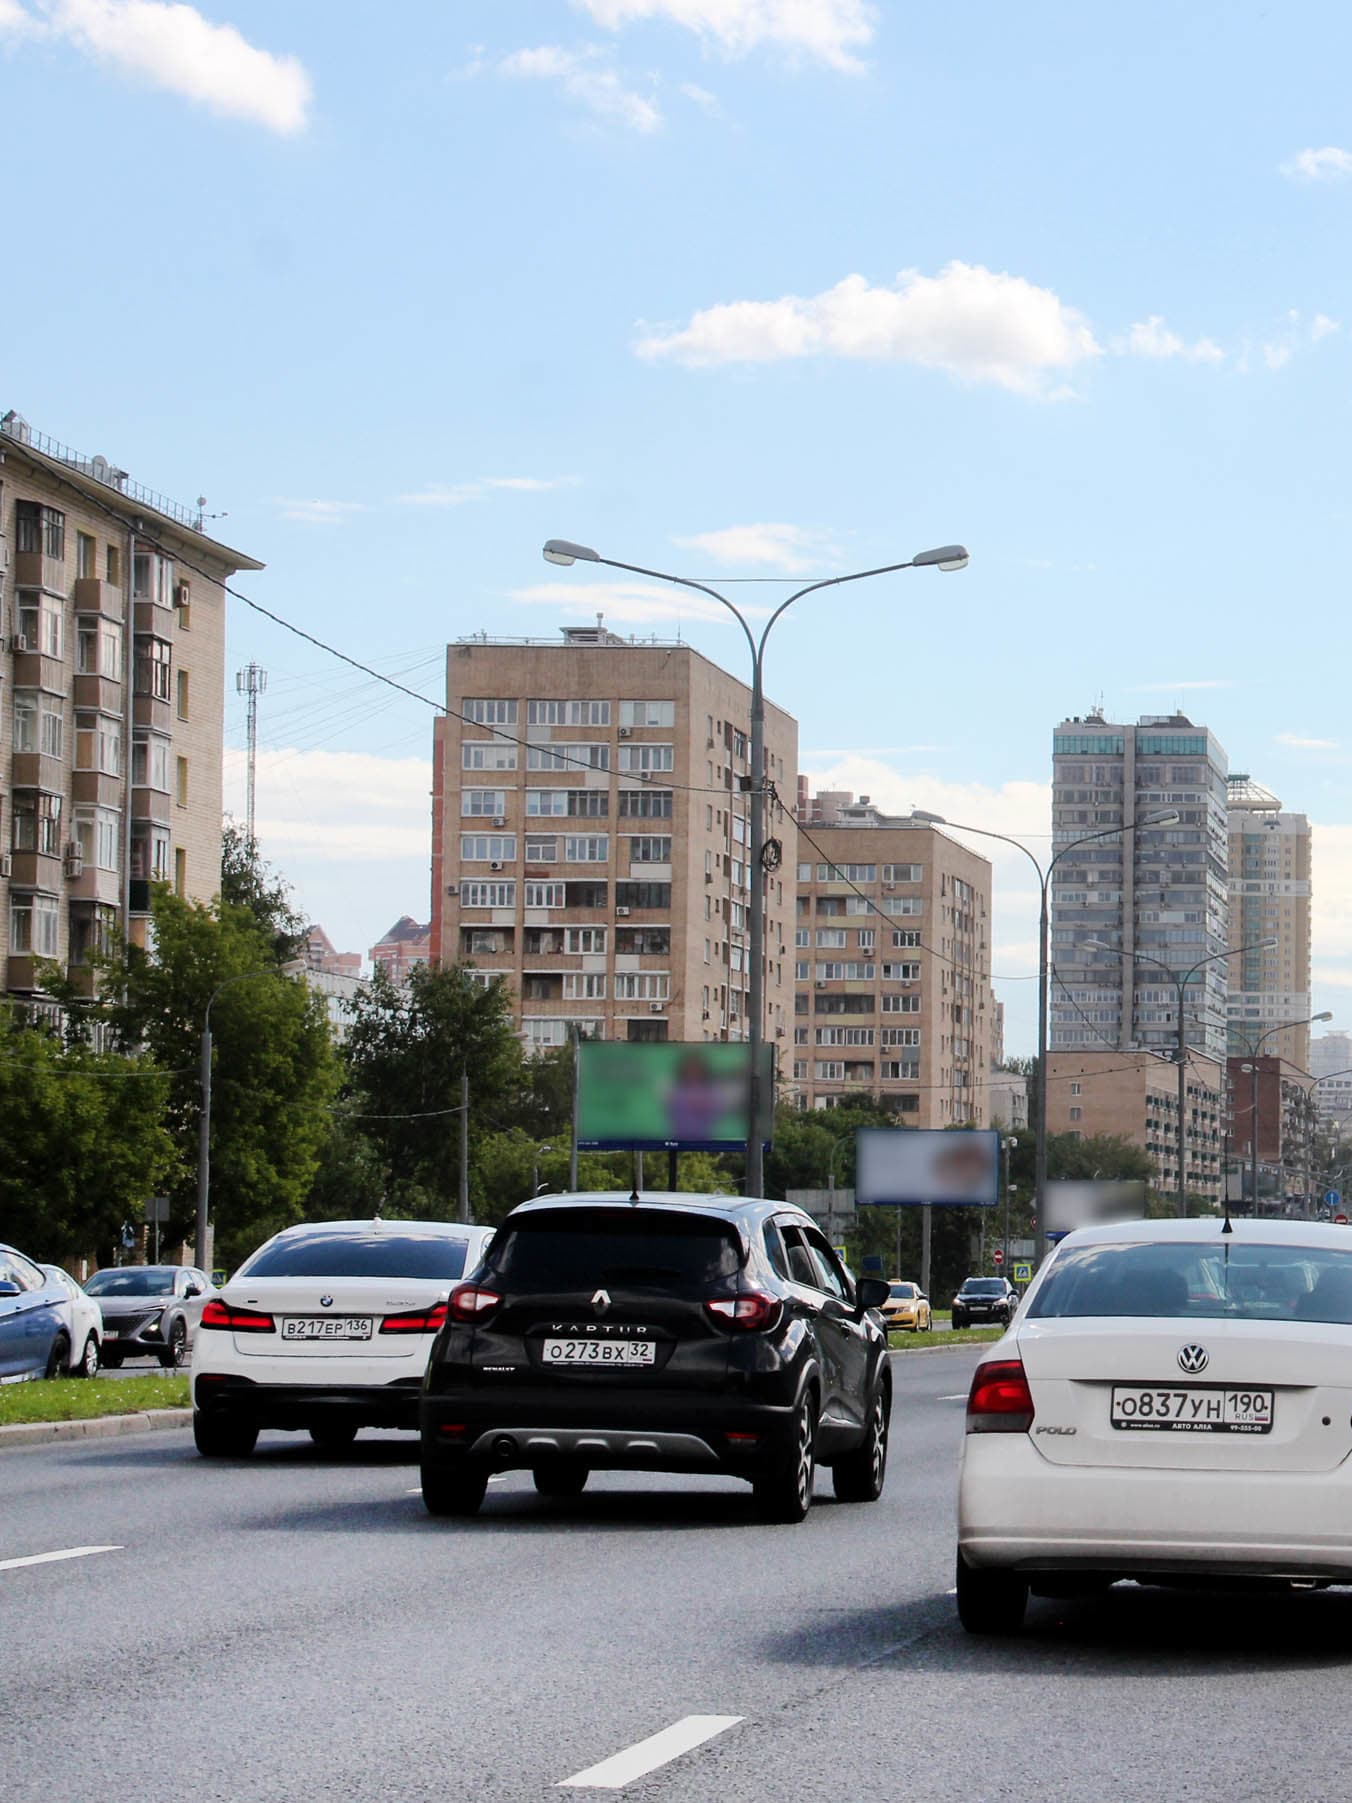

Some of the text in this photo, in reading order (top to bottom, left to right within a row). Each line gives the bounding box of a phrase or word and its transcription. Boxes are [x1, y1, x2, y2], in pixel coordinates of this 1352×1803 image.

[287, 1319, 368, 1334] В217ЕР 136
[630, 1342, 650, 1357] 32
[1121, 1392, 1265, 1419] О837УН 190
[1234, 1413, 1254, 1421] RUS
[1035, 1426, 1077, 1435] POLO
